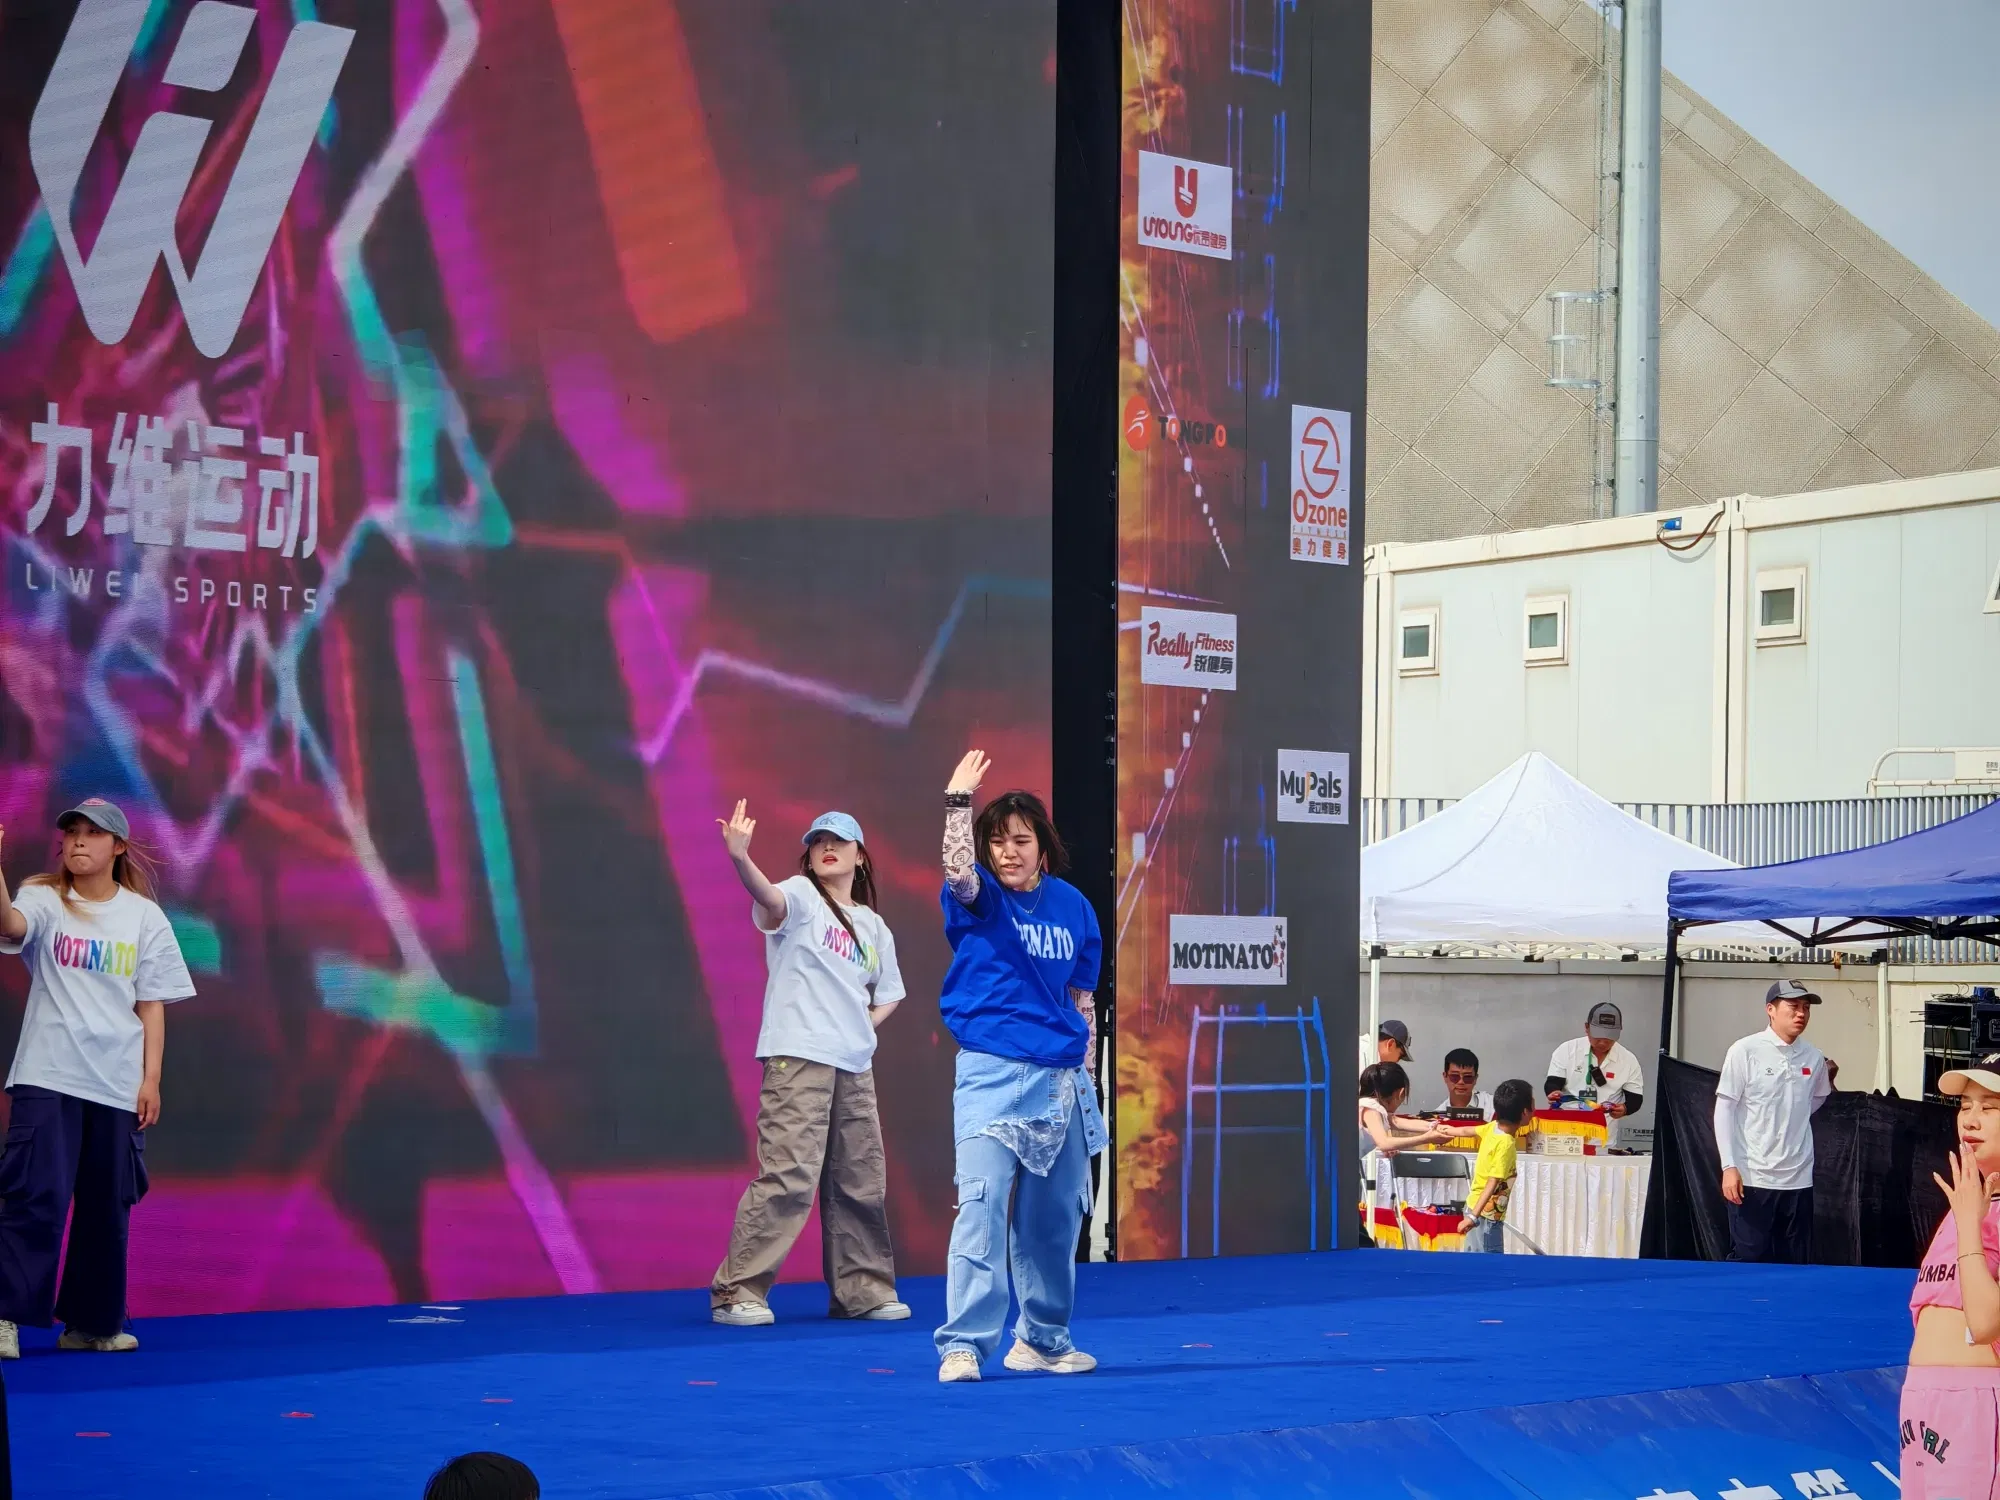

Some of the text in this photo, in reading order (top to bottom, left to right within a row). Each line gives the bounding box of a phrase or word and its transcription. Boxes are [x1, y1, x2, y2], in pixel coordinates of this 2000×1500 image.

[27, 402, 319, 558] 力维运动
[1293, 489, 1347, 527] Ozone
[1293, 537, 1346, 559] 奥力健身
[26, 563, 317, 613] LIWEI SPORTS
[1147, 620, 1234, 669] Really Fitness
[1280, 769, 1342, 804] MyPals
[1173, 942, 1273, 969] MOTINATO
